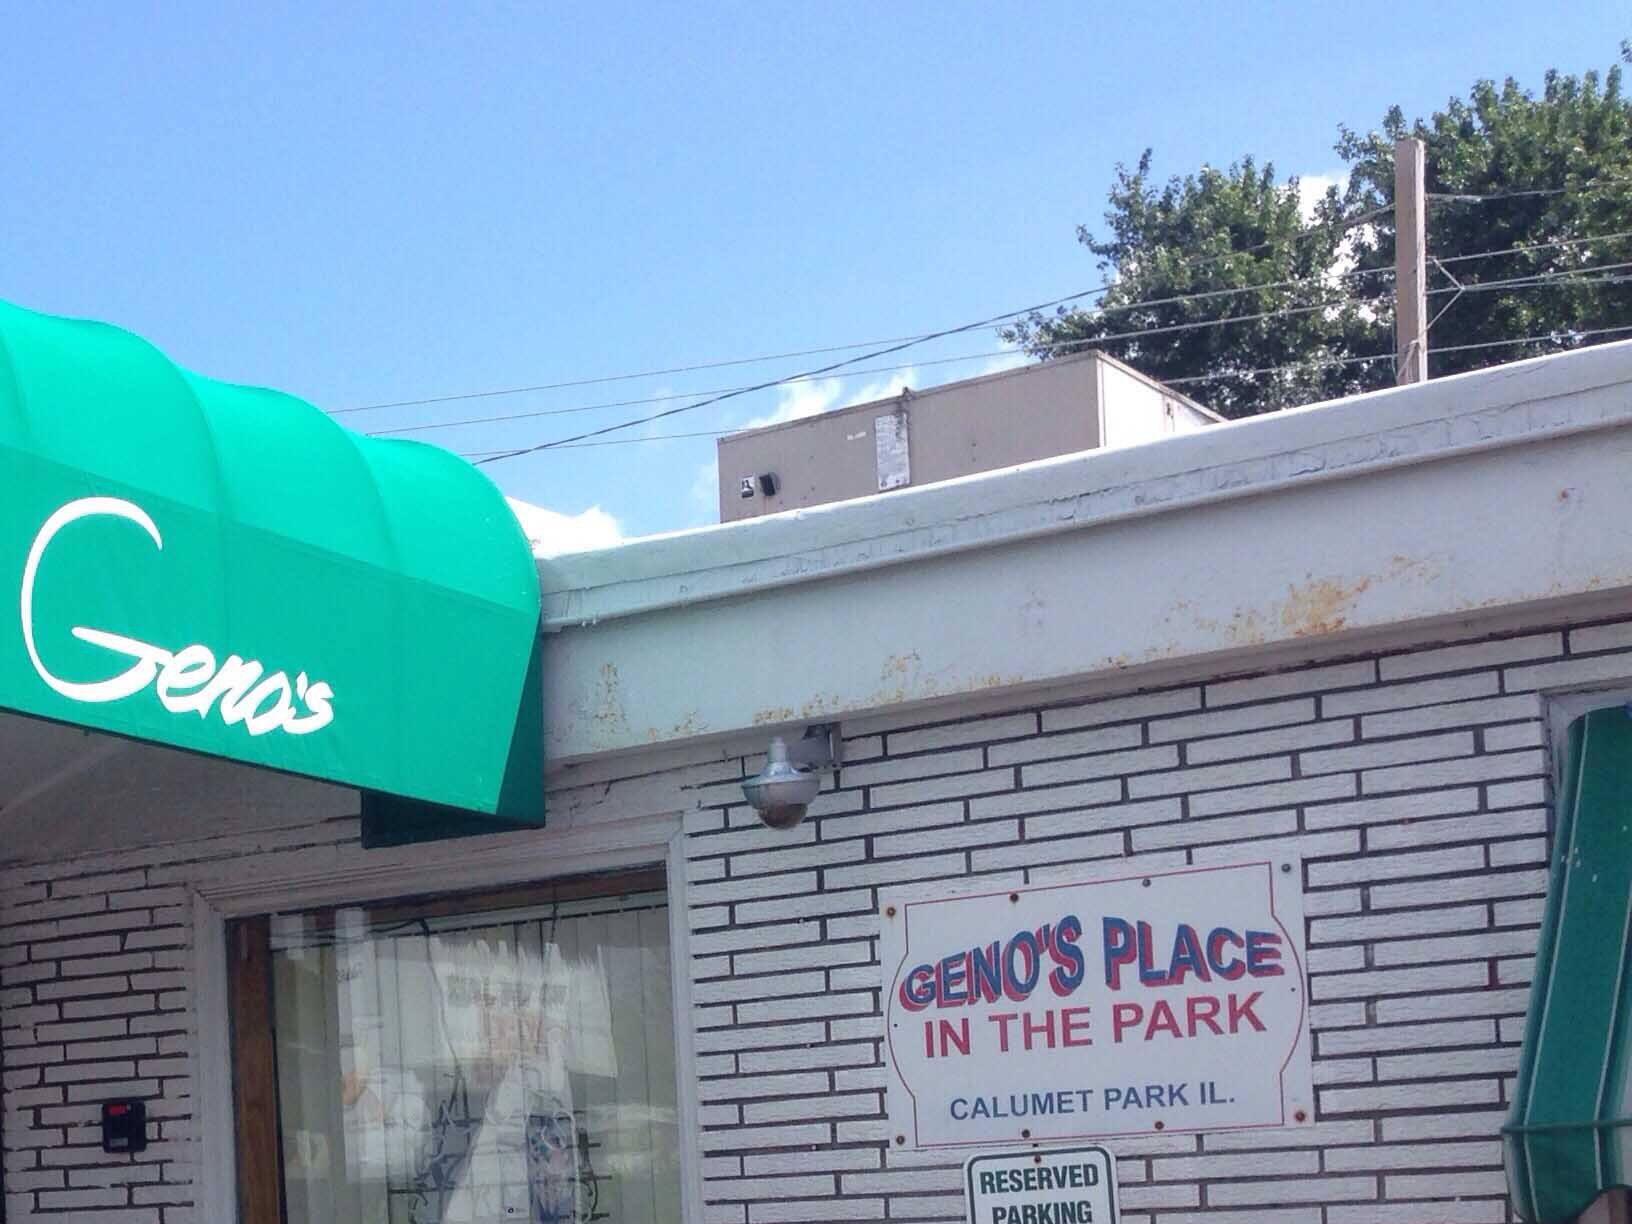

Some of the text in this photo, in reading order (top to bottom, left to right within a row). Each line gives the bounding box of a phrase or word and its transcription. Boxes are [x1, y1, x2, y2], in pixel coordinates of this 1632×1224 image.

[20, 496, 335, 736] Geno's
[899, 914, 1284, 1012] GENO'S PLACE
[923, 991, 1267, 1058] IN THE PARK
[949, 1080, 1236, 1121] CALUMET PARK IL.
[980, 1163, 1099, 1195] RESERVED
